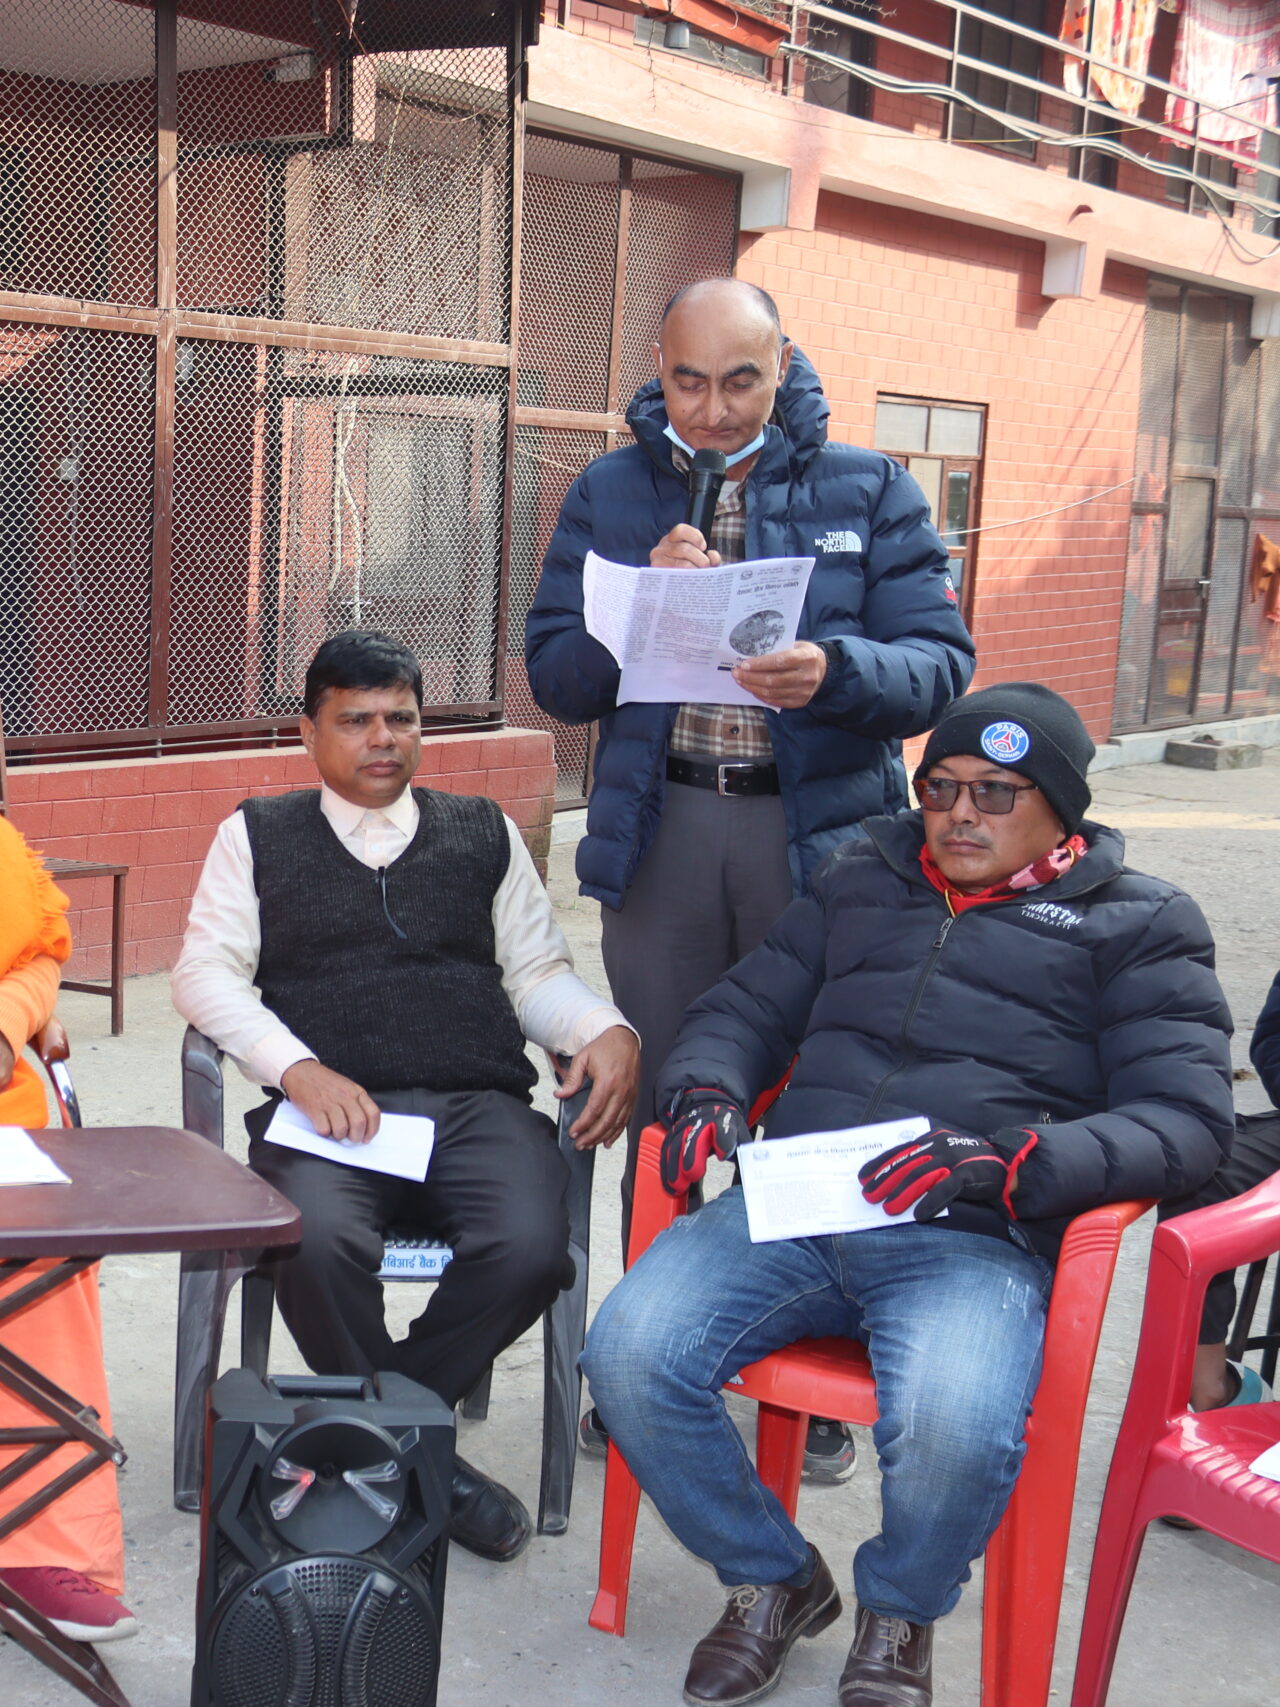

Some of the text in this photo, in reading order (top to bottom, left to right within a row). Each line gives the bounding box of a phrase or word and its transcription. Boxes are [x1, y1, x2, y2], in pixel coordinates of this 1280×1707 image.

[825, 531, 846, 540] THE
[814, 538, 846, 546] NORTH
[823, 545, 846, 553] FACE
[996, 724, 1025, 739] PARIS
